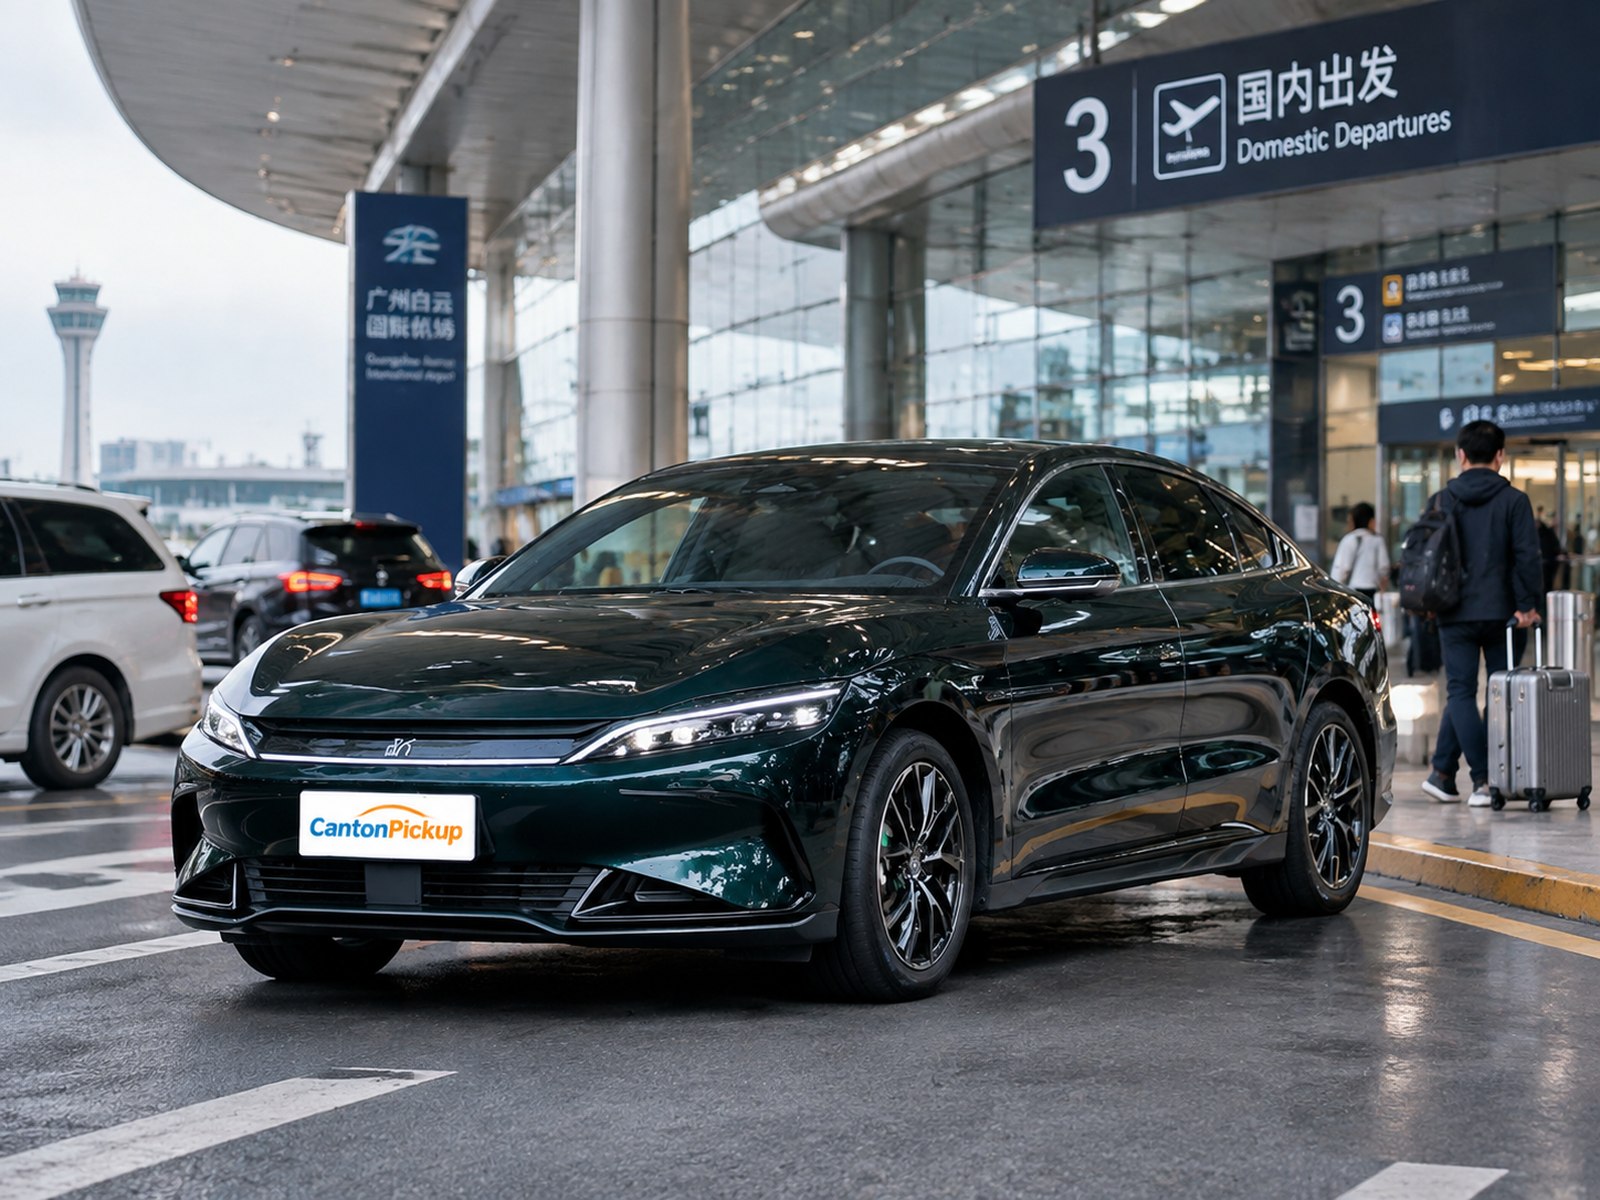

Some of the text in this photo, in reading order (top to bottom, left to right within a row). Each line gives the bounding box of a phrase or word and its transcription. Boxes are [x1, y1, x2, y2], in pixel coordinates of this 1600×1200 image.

[1237, 44, 1398, 126] 国内出发
[1063, 97, 1112, 194] 3
[1237, 126, 1329, 165] Domestic
[1334, 107, 1452, 150] Departures
[1335, 285, 1365, 343] 3
[309, 816, 463, 845] CantonPickup
